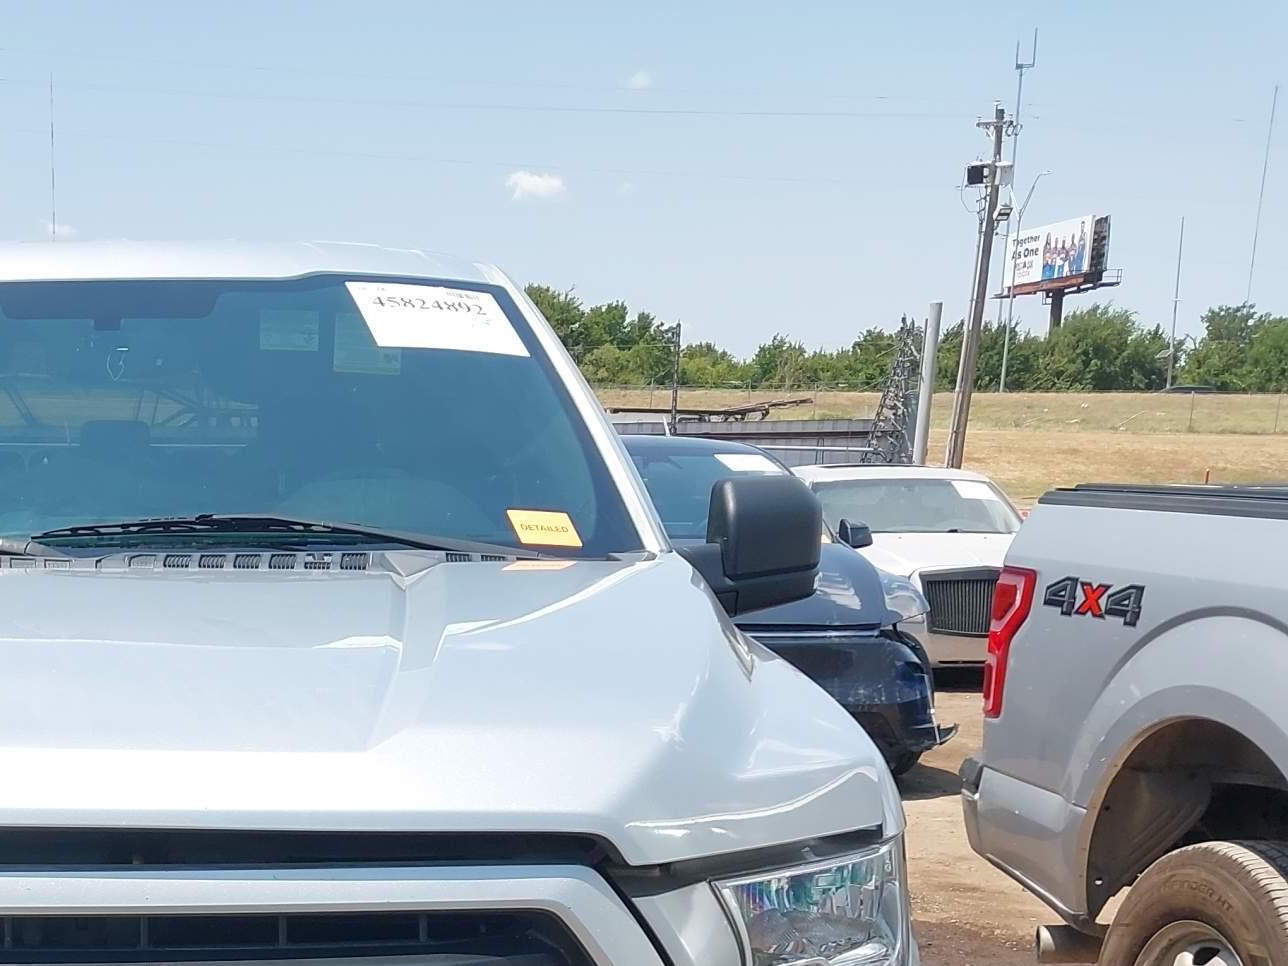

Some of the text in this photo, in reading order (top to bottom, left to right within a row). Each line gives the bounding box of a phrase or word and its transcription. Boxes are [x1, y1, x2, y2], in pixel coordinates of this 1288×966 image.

[1023, 248, 1039, 258] One
[372, 296, 487, 316] 45824892
[520, 523, 569, 533] DETAILED
